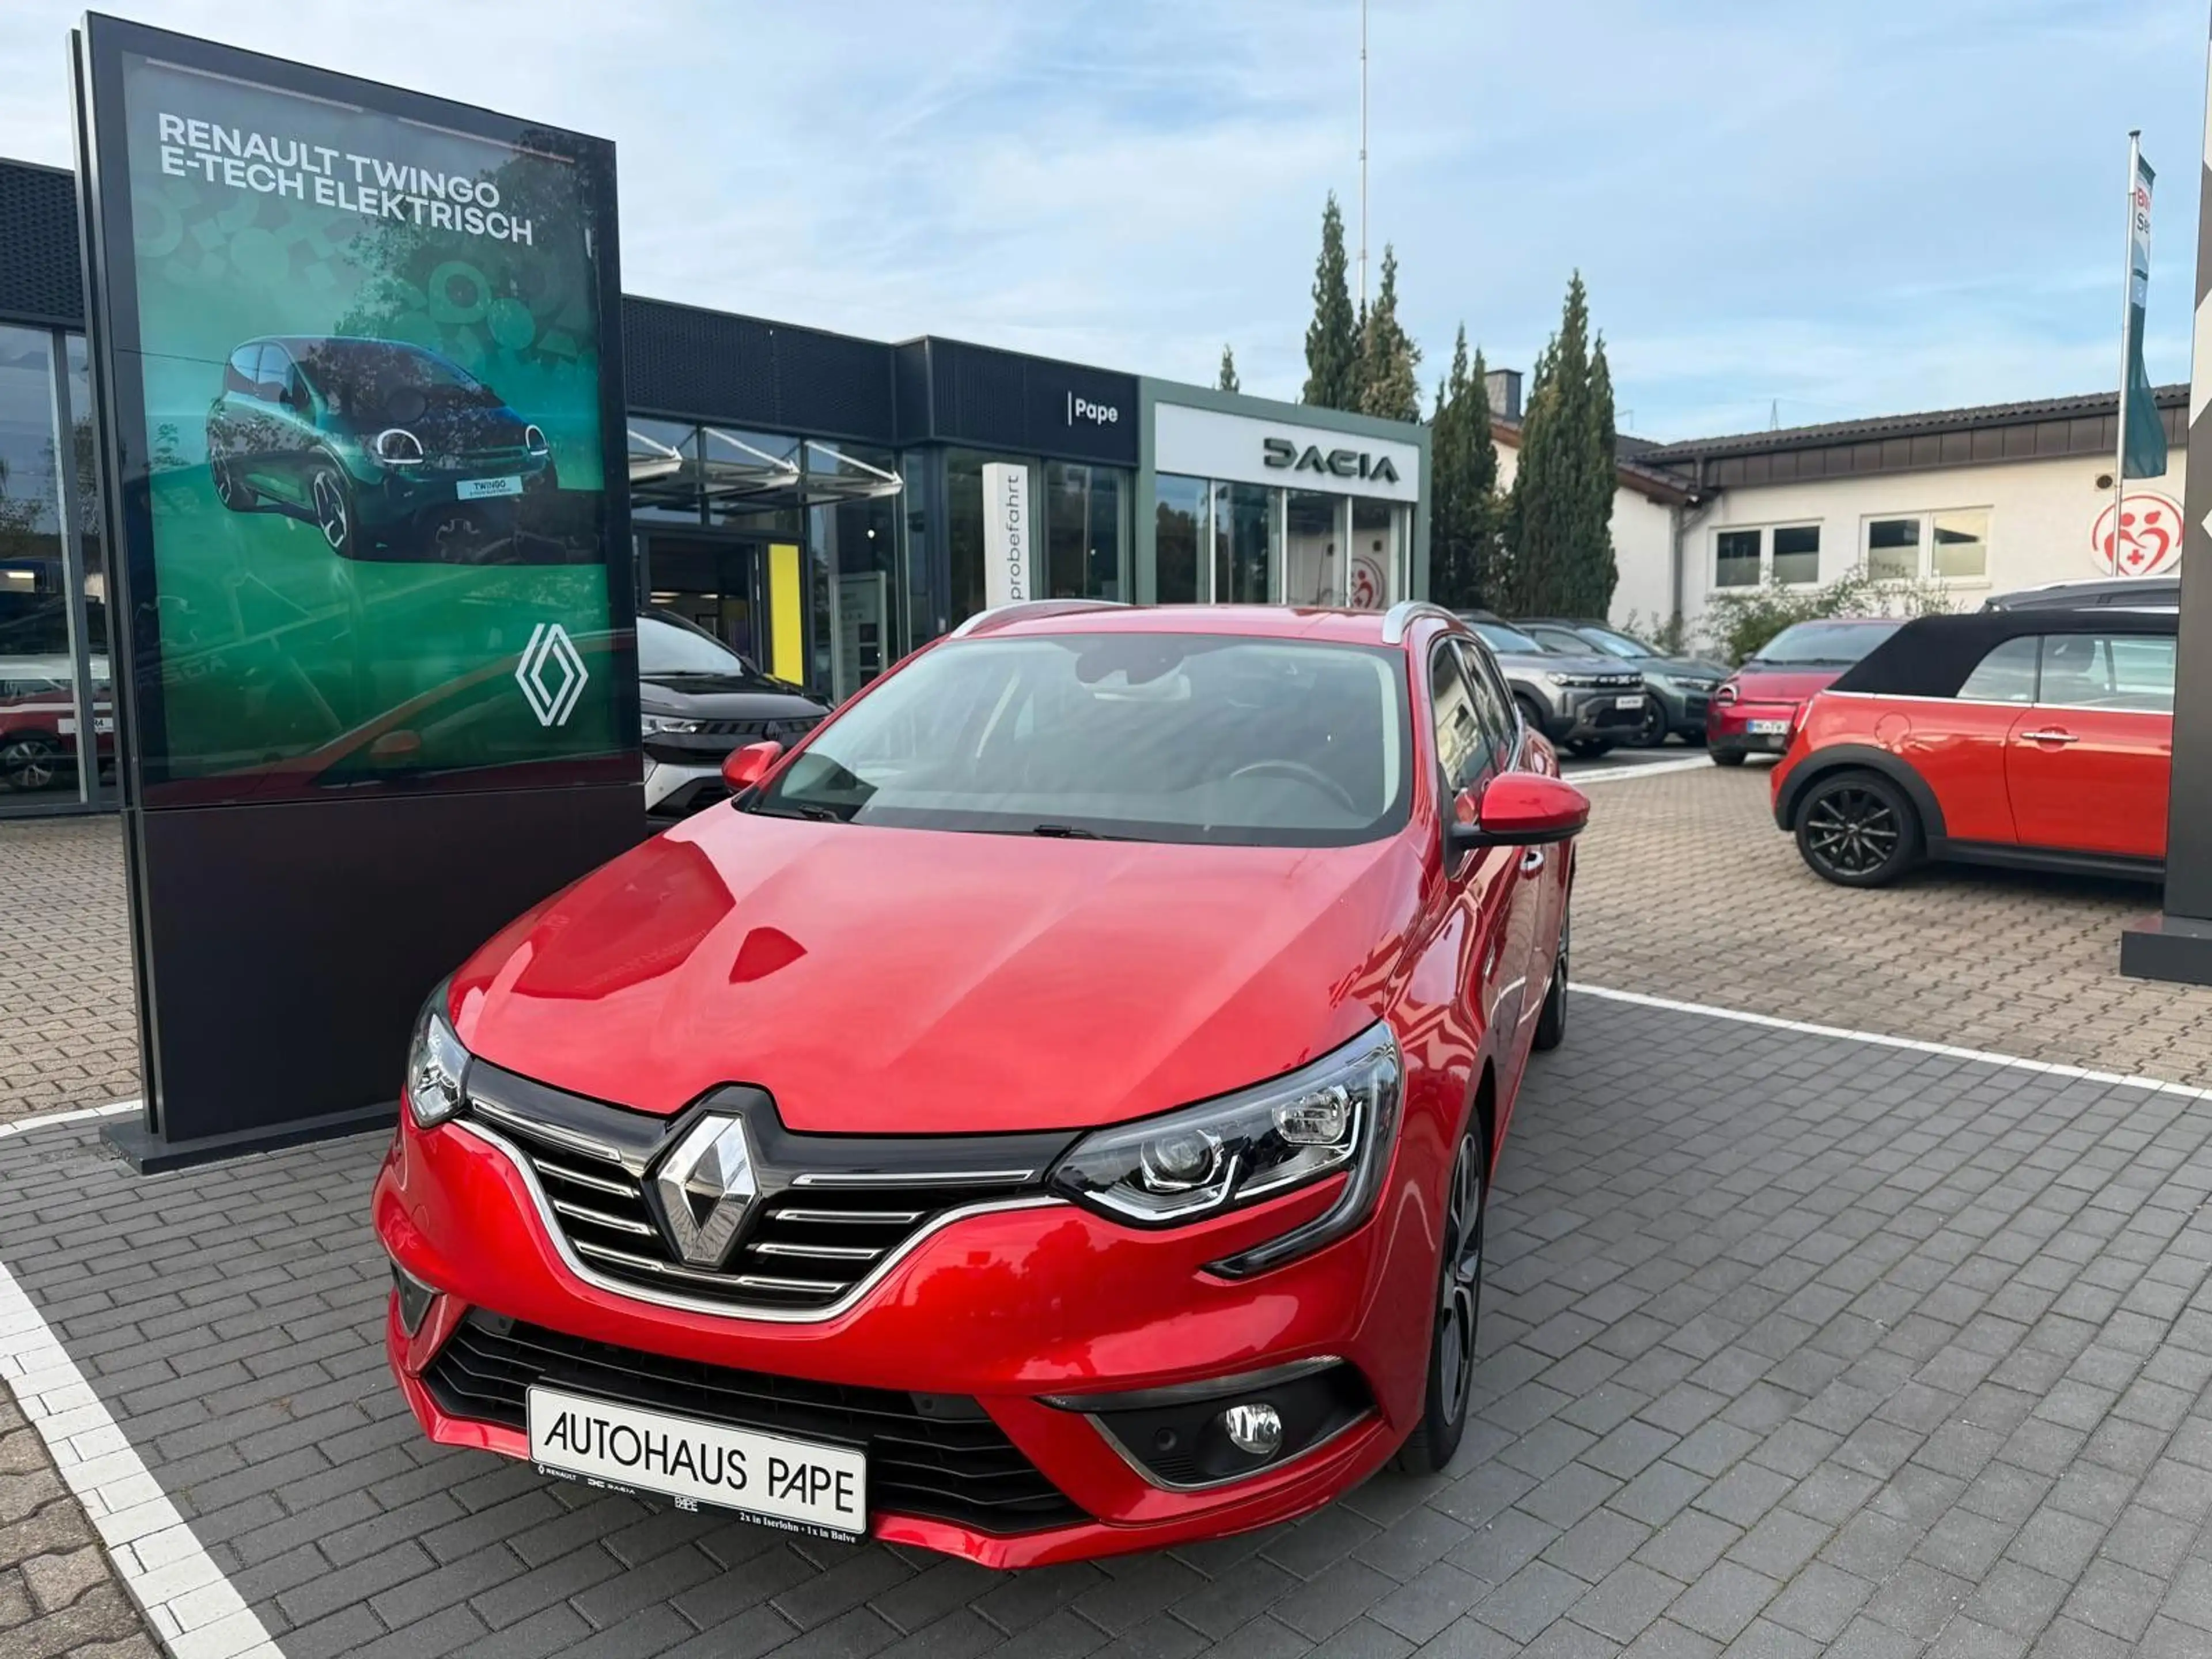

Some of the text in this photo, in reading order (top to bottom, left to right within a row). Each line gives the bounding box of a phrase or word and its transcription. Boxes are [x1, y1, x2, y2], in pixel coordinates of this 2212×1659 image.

[158, 113, 500, 209] RENAULT TWINGO
[161, 145, 533, 245] E-TECH ELEKTRISCH
[1075, 397, 1118, 425] Pape
[1264, 437, 1400, 485] DACIA
[1006, 475, 1024, 600] probefahrt
[544, 1411, 854, 1513] AUTOHAUS PAPE
[547, 1468, 577, 1481] RENAULT
[739, 1512, 751, 1522] 2x
[752, 1515, 762, 1525] in
[763, 1517, 799, 1532] Iserlohn
[820, 1528, 829, 1538] in
[831, 1531, 856, 1543] Balve
